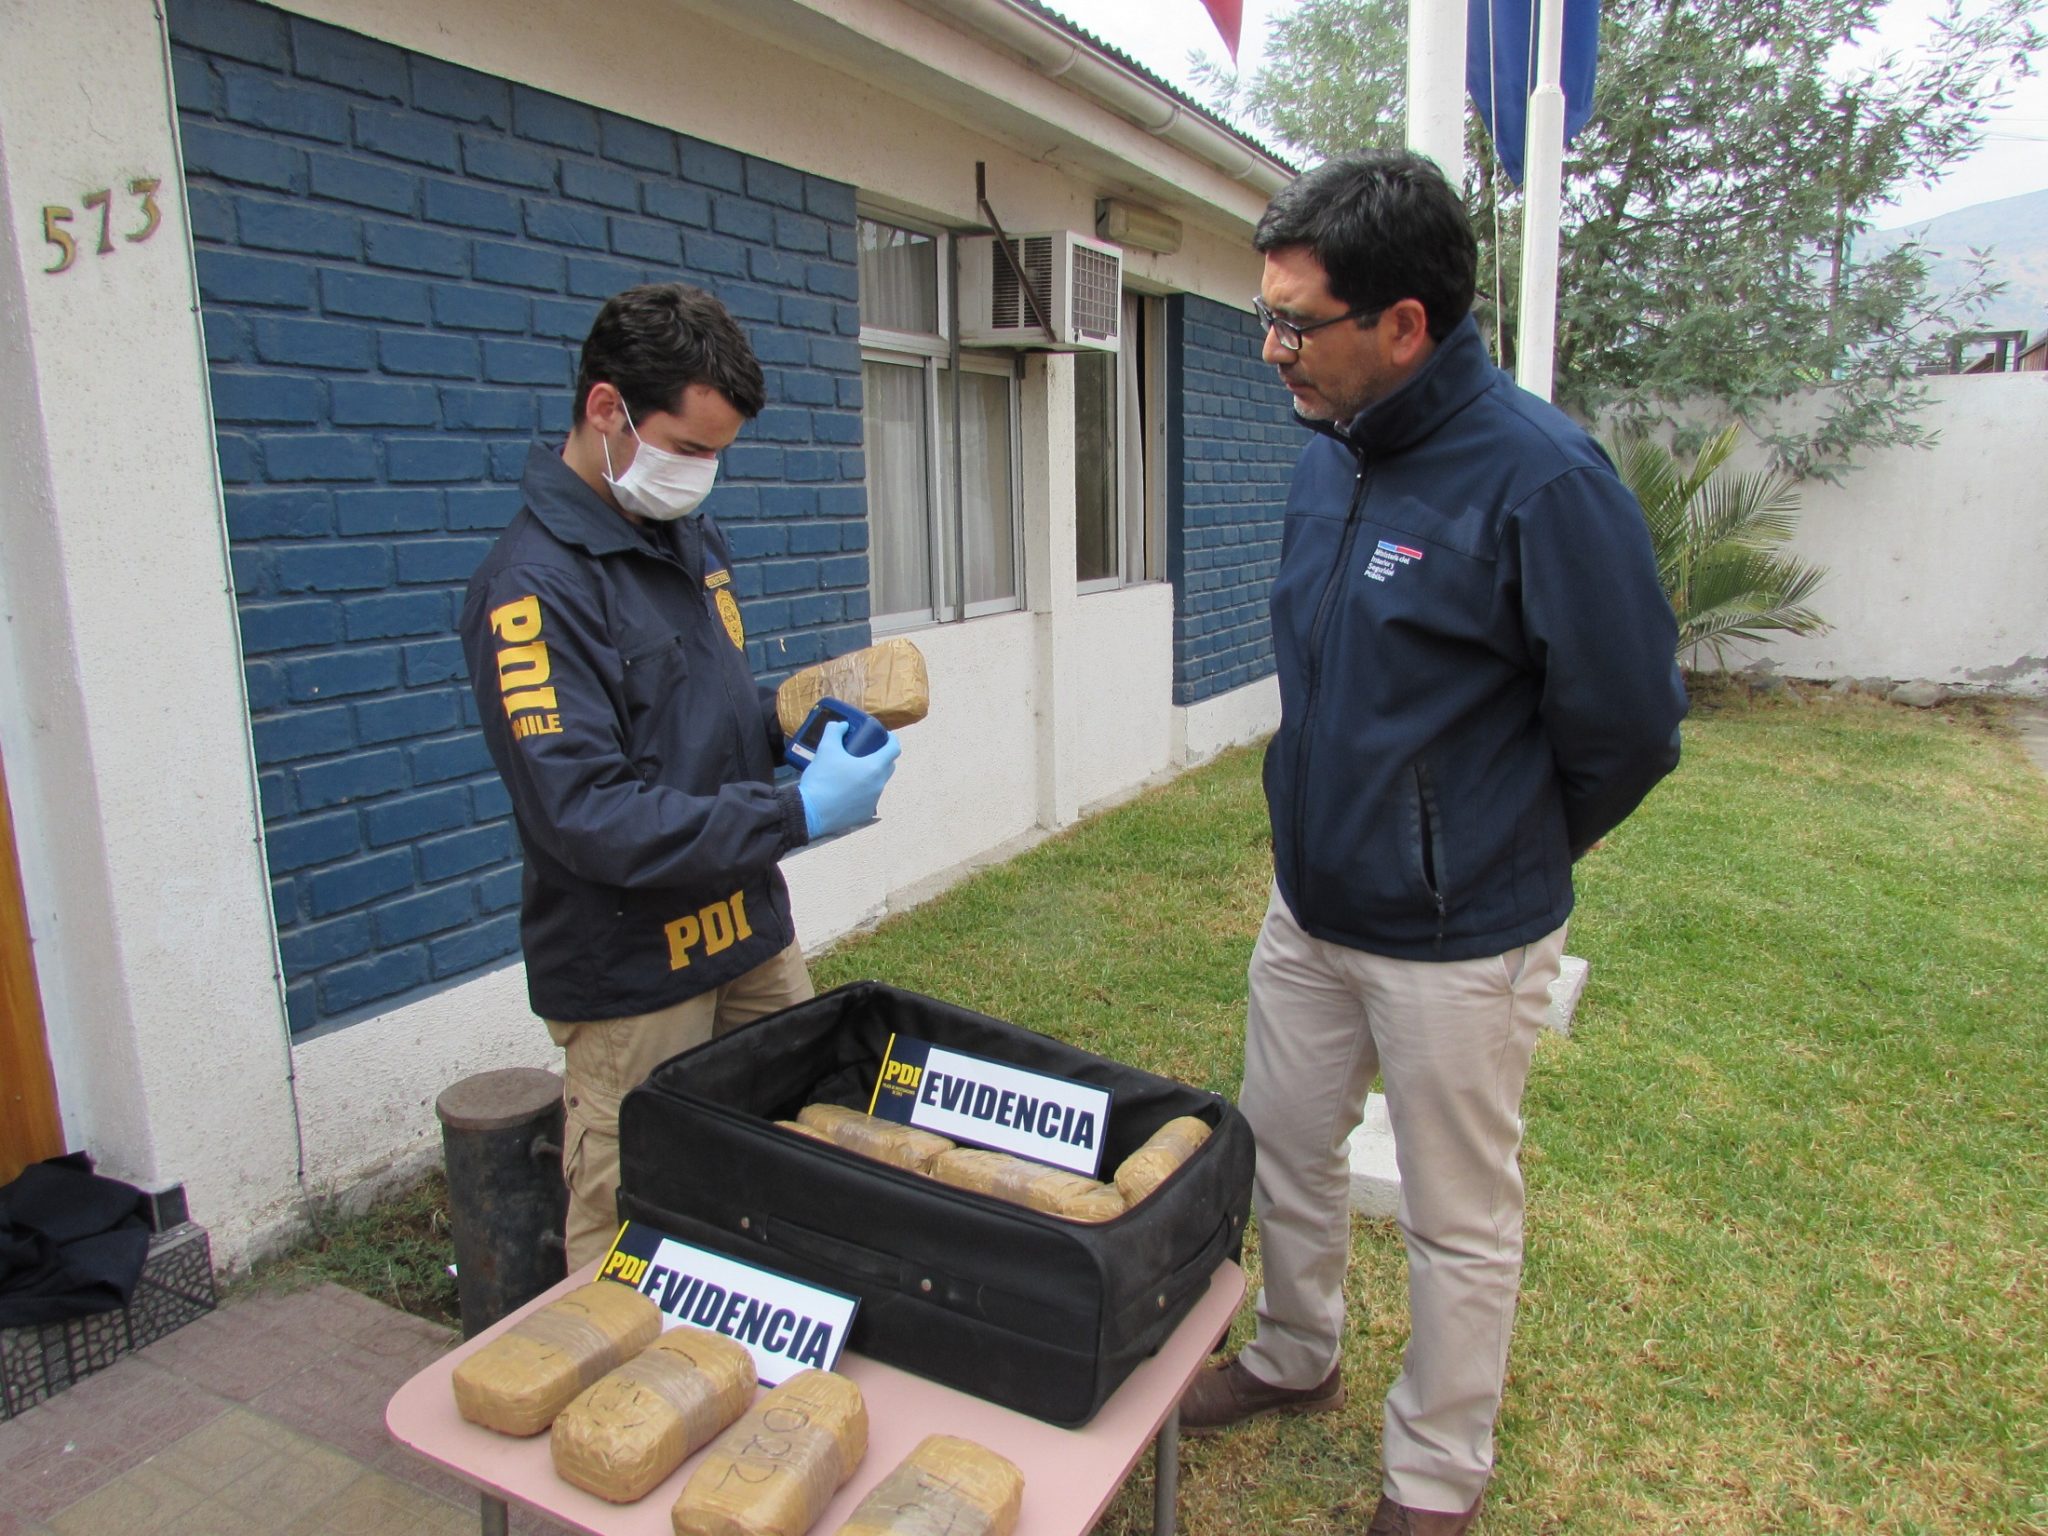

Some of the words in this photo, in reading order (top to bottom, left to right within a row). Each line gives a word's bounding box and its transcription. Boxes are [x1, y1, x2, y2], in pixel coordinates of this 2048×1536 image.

[42, 178, 161, 274] 573
[490, 594, 558, 719] PDI
[664, 889, 752, 971] PDI
[884, 1060, 923, 1088] PDI
[920, 1070, 1095, 1150] EVIDENCIA
[604, 1250, 649, 1284] PDI
[642, 1264, 834, 1370] EVIDENCIA
